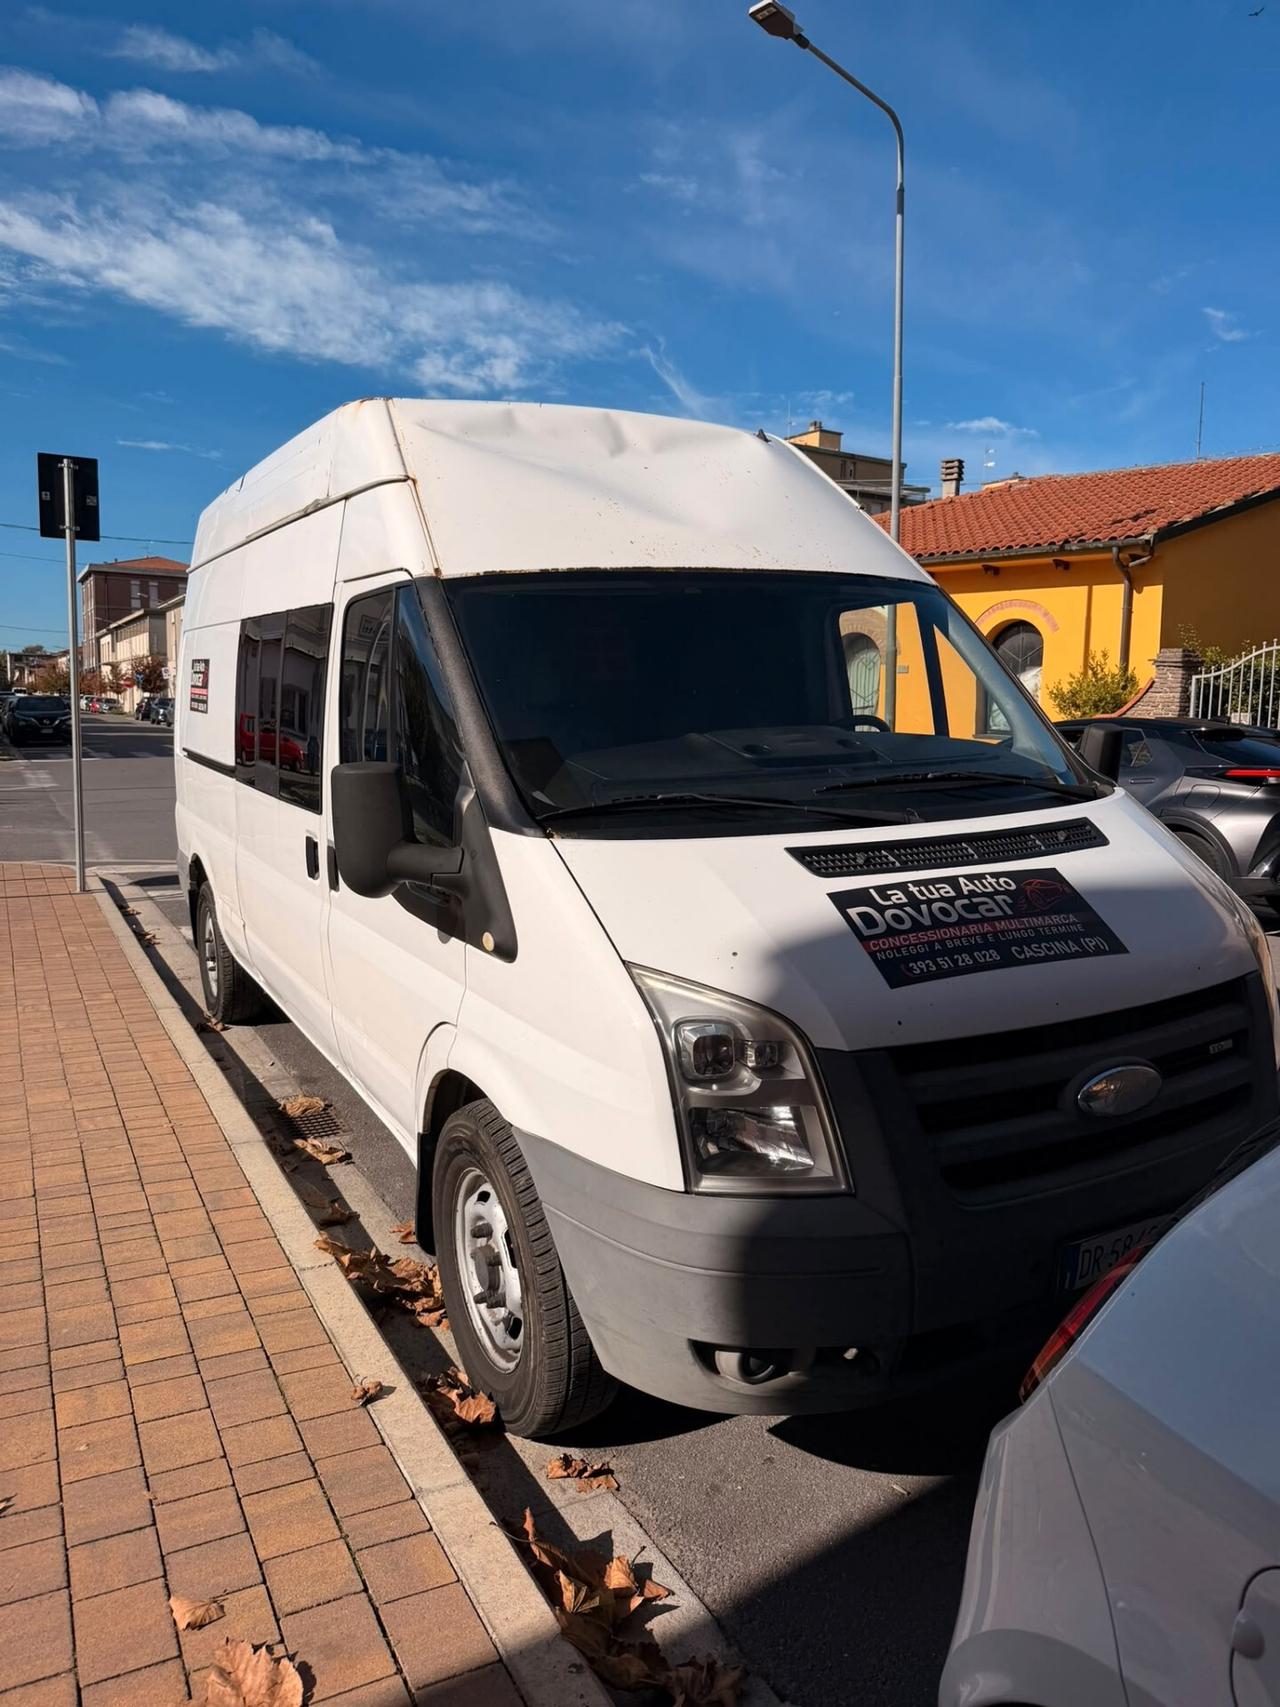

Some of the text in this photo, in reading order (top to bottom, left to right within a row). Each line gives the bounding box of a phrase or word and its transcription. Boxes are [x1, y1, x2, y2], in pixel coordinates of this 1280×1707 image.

[868, 874, 1017, 905] La tua Auto
[846, 894, 1014, 936] Dovocar
[869, 914, 1079, 951] CONCESSIONARIA MULTIMARCA
[876, 924, 1086, 960] NOLEGGI A BREVE E LUNGO TERMINE
[908, 936, 1109, 975] 393 51 28 028 CASCINA (PI)
[1079, 1245, 1104, 1281] DR
